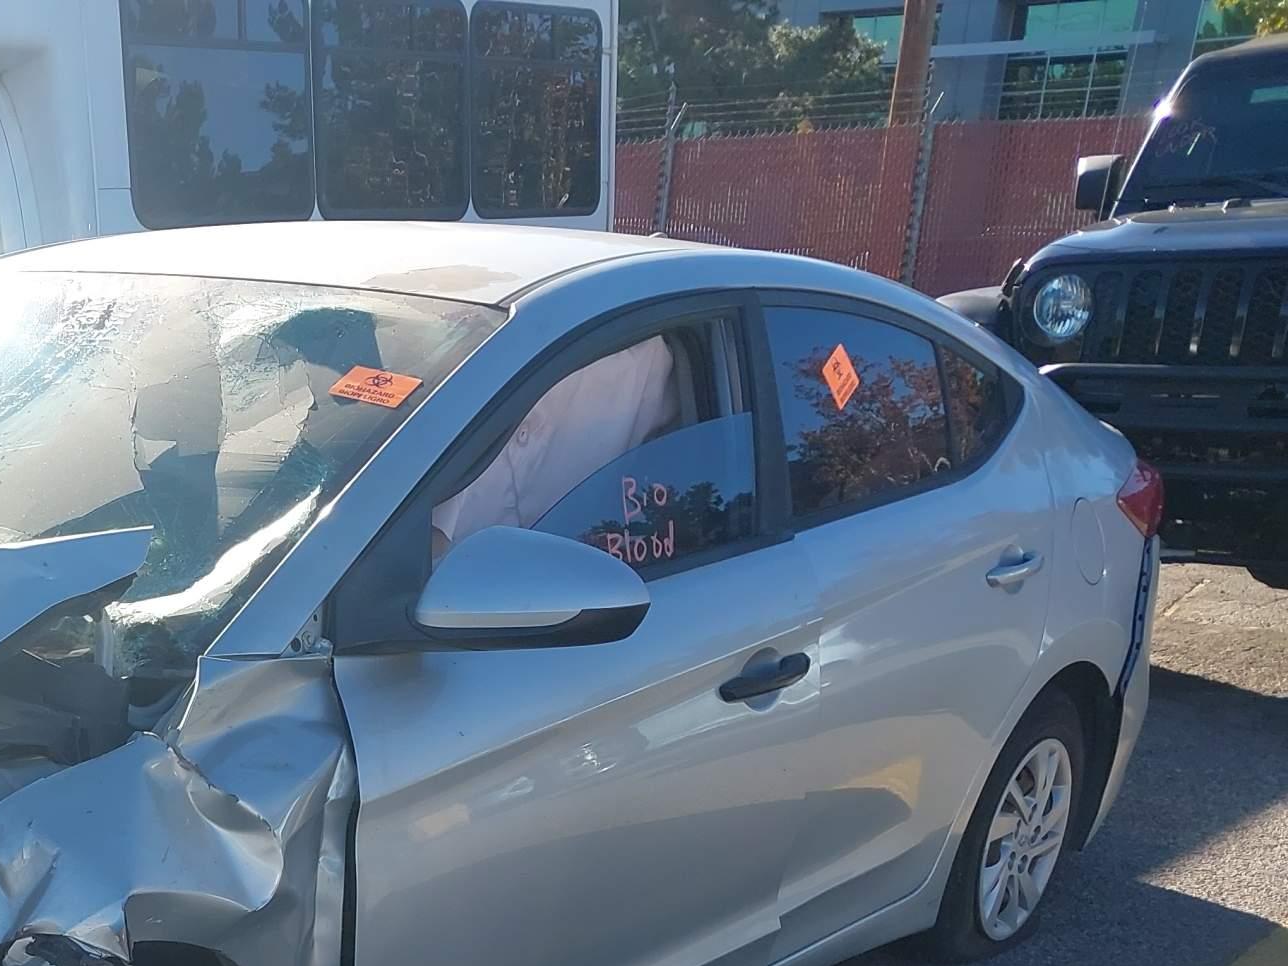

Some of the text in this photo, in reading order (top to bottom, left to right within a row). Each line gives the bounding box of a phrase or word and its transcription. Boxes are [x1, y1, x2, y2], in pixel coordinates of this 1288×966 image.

[344, 383, 396, 398] BIOHAZARD
[622, 475, 667, 524] Bio
[607, 520, 674, 562] Blood
